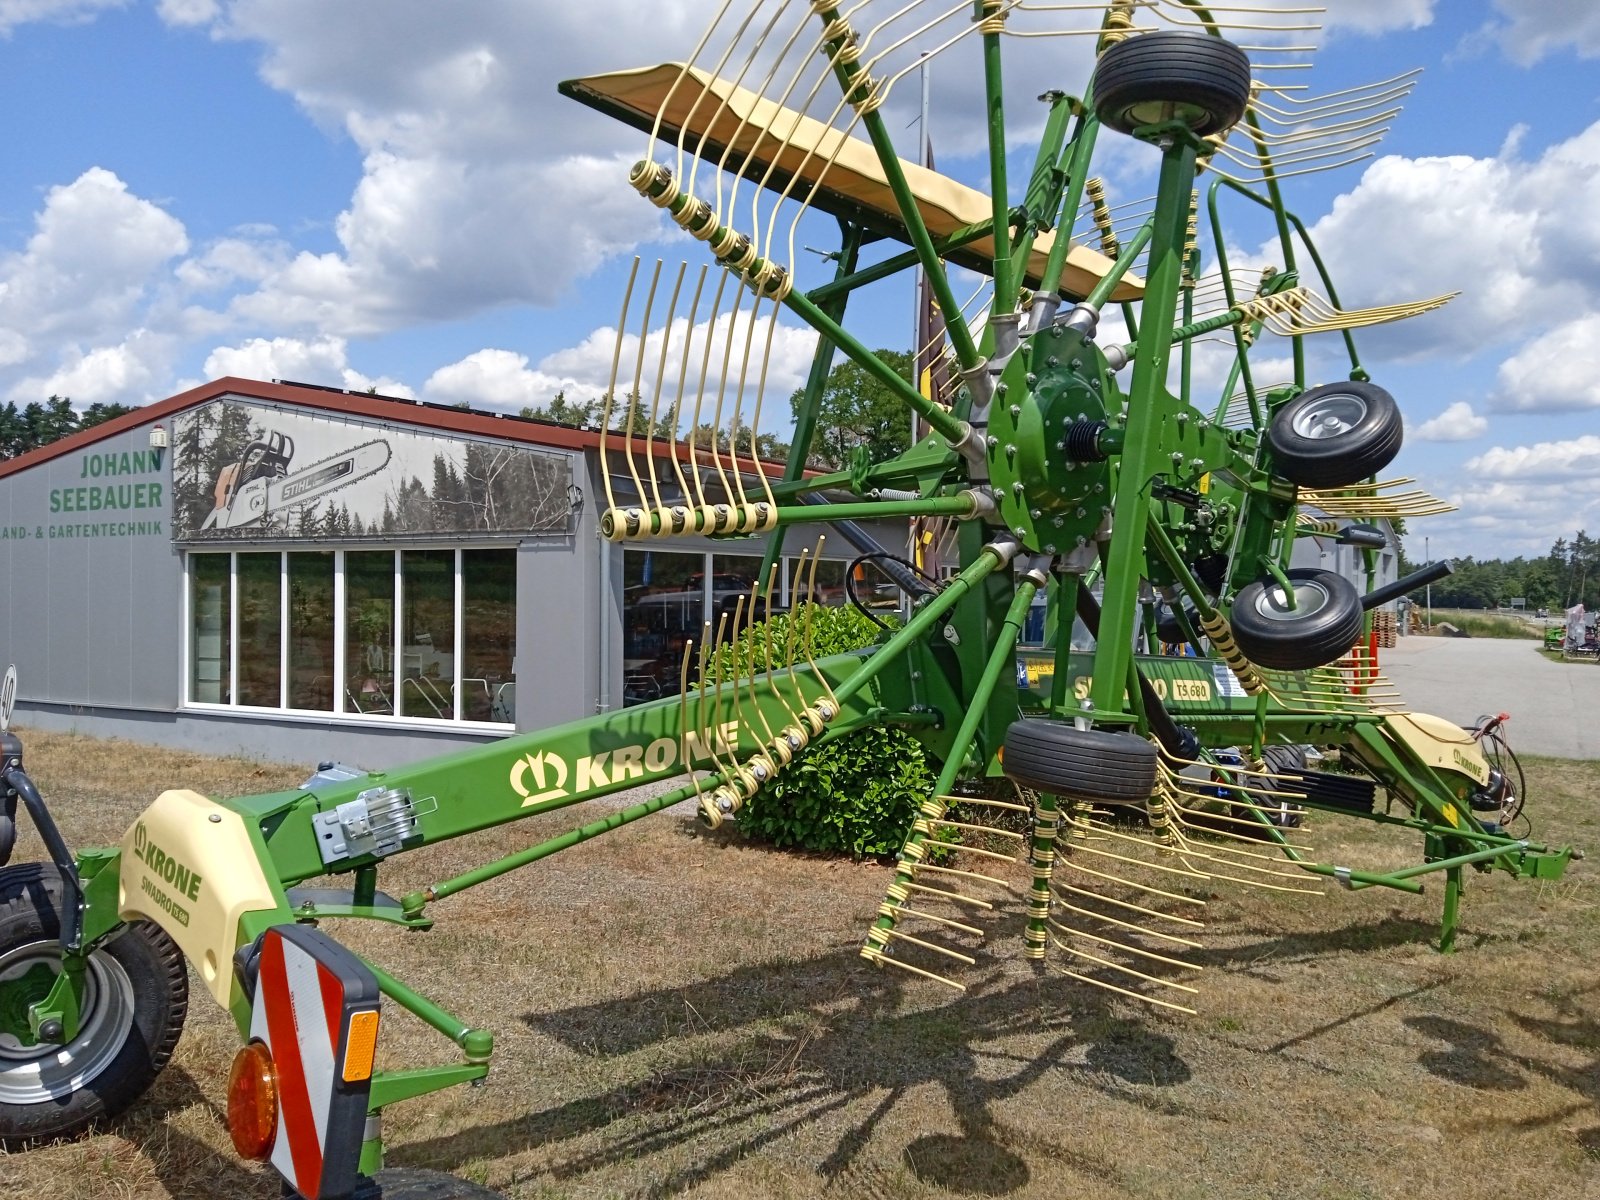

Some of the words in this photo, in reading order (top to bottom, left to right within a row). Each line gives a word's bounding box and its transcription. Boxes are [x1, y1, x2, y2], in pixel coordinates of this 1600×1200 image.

[80, 449, 161, 478] JOHANN
[50, 482, 162, 513] SEEBAUER
[283, 477, 312, 498] STIHL
[0, 526, 31, 540] AND-
[35, 525, 44, 539] &
[49, 520, 162, 539] GARTENTECHNIK
[2, 675, 14, 721] 40
[1176, 684, 1188, 697] TS
[1190, 684, 1206, 697] 680
[575, 720, 738, 793] KRONE
[1461, 756, 1482, 777] KRONE
[145, 841, 202, 903] KRONE
[141, 875, 171, 914] SWADRO
